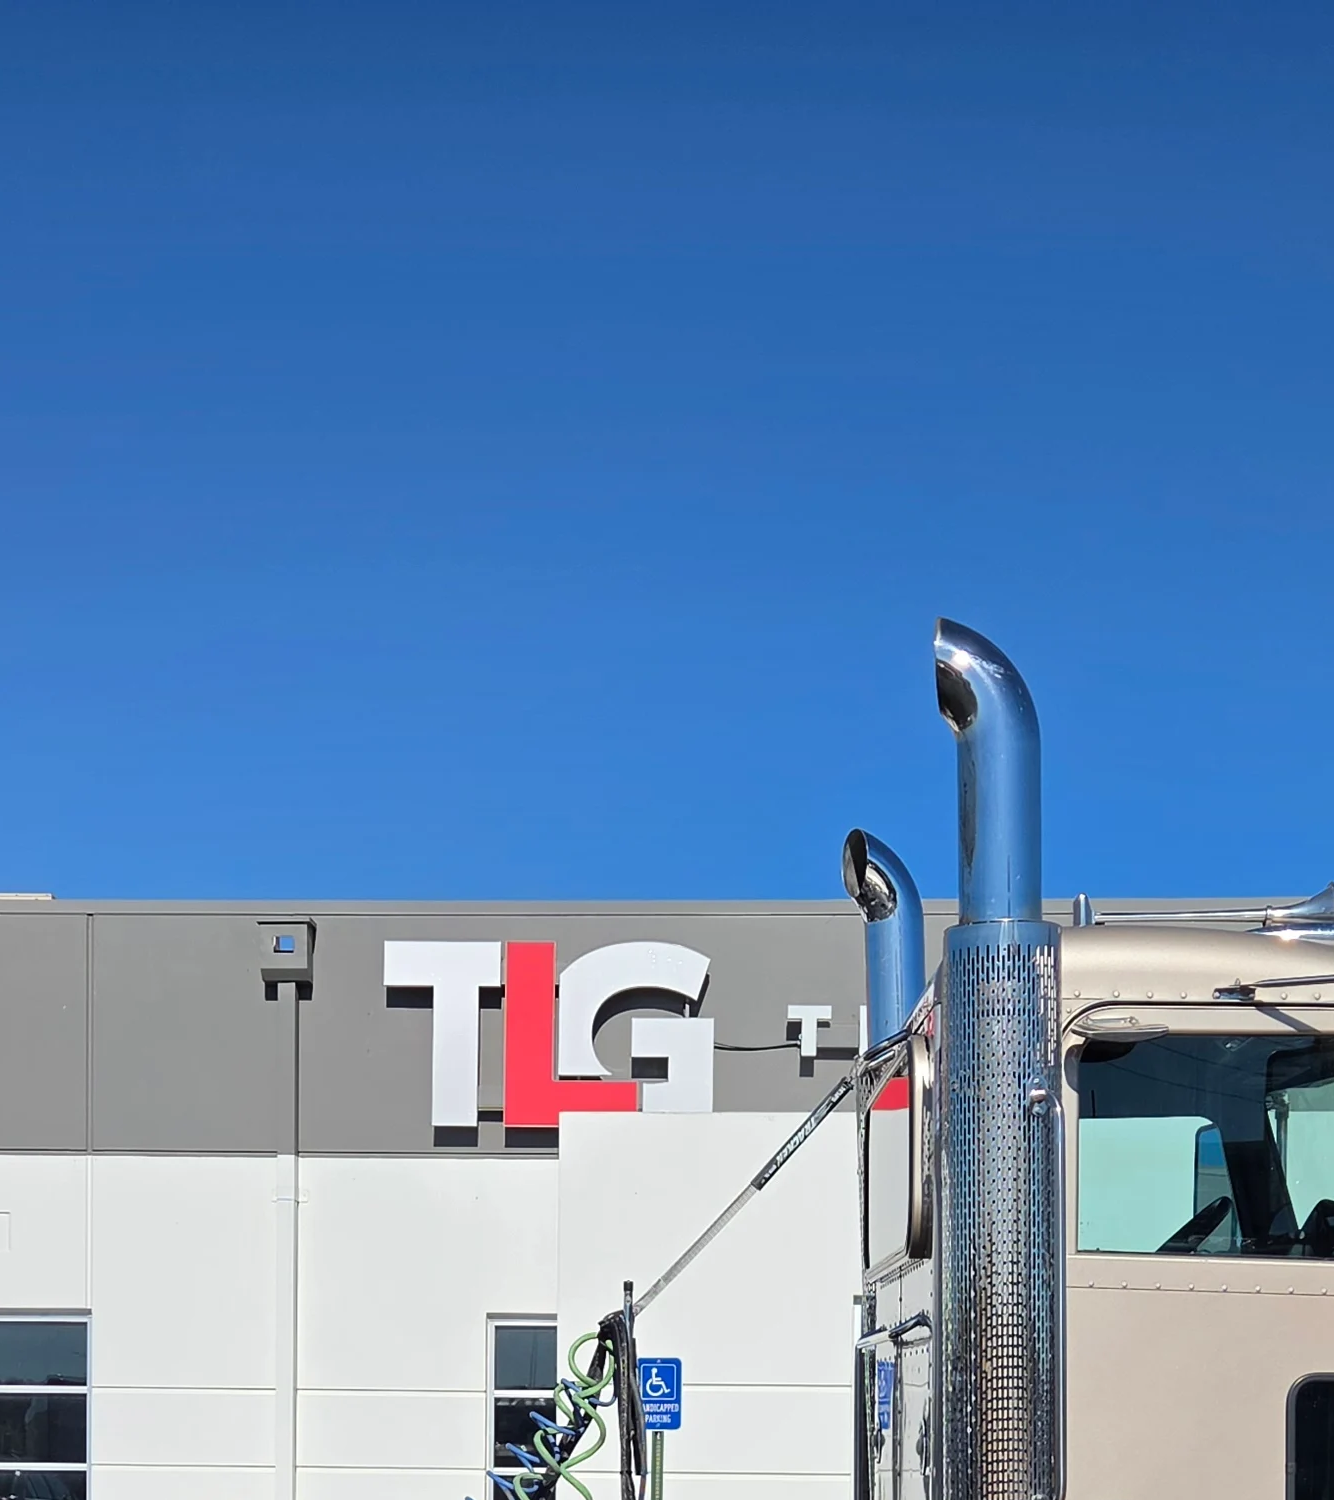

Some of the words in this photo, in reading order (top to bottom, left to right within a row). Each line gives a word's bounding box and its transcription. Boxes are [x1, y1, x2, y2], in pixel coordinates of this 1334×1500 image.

[384, 940, 714, 1127] TLG
[643, 1403, 679, 1413] ANDICAPPED
[645, 1414, 672, 1423] PARKING
